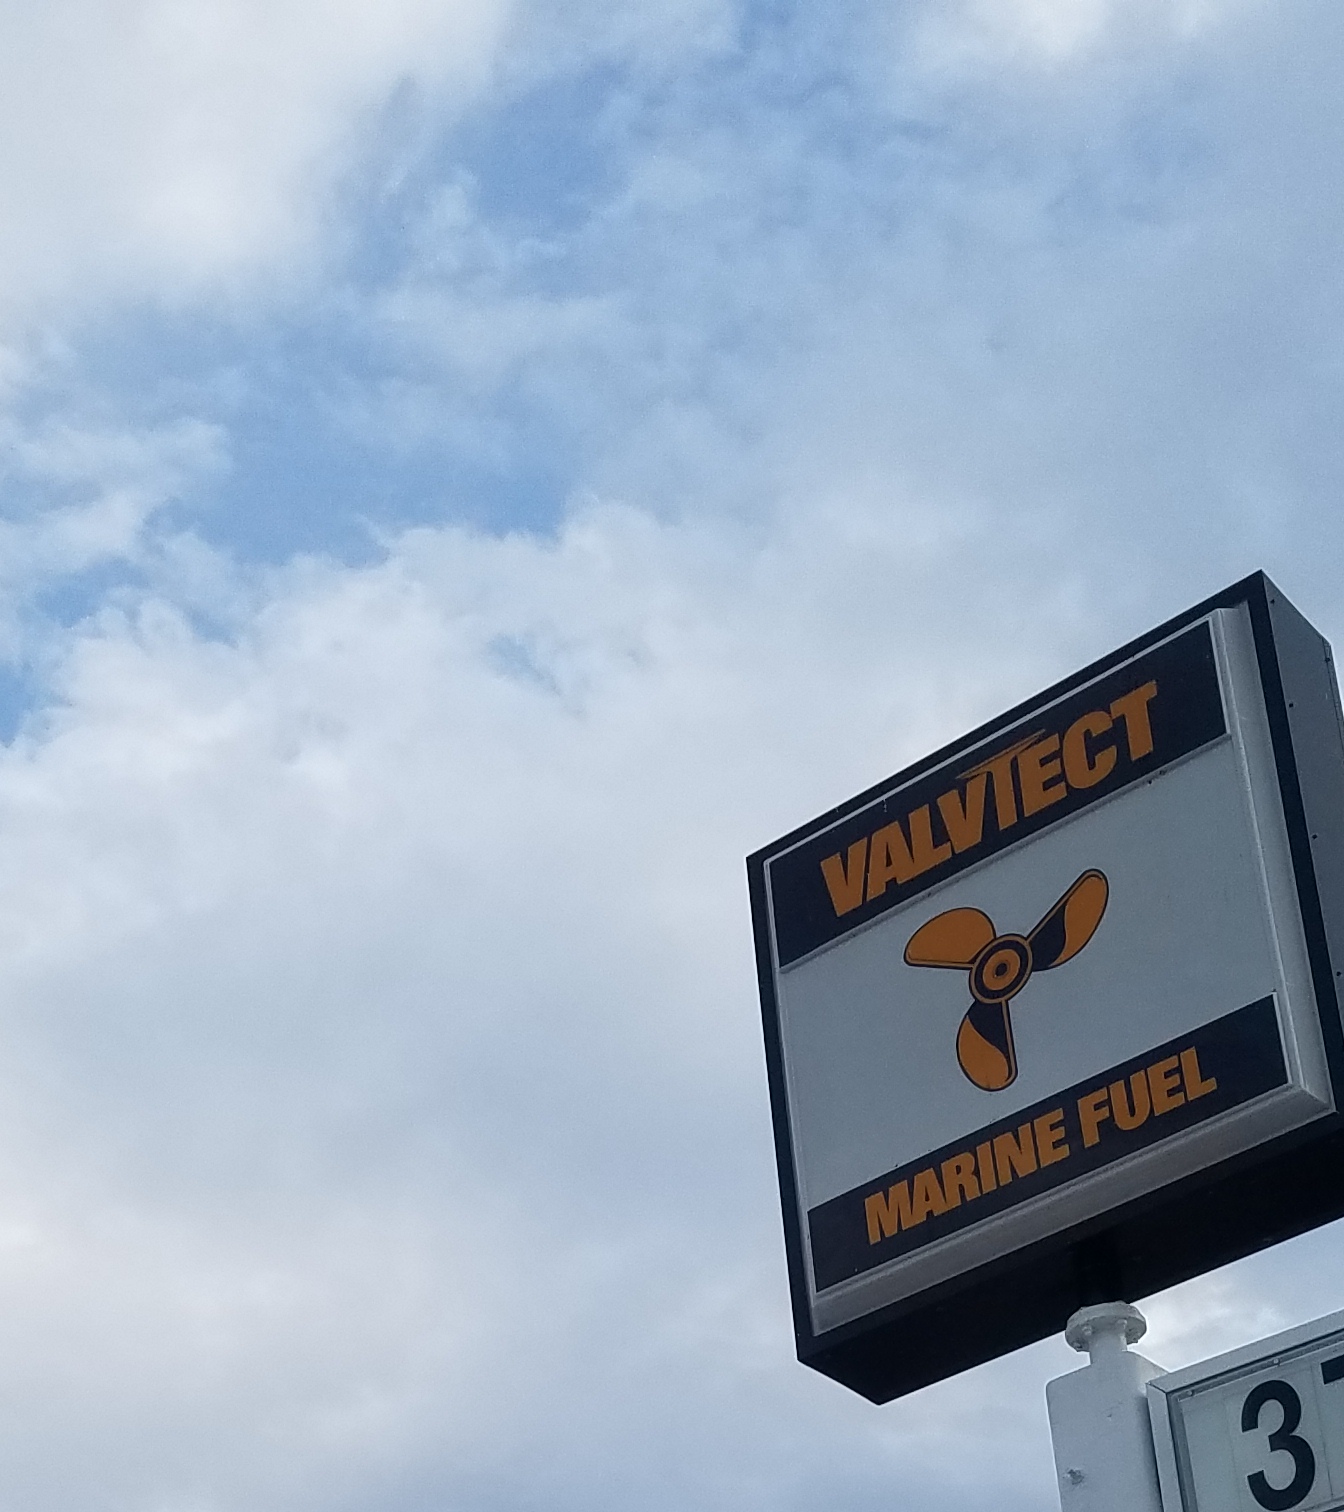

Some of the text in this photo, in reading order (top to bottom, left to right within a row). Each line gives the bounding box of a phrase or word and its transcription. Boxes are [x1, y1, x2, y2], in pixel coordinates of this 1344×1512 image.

[820, 680, 1157, 917] VALVTECT
[864, 1046, 1217, 1245] MARINE FUEL
